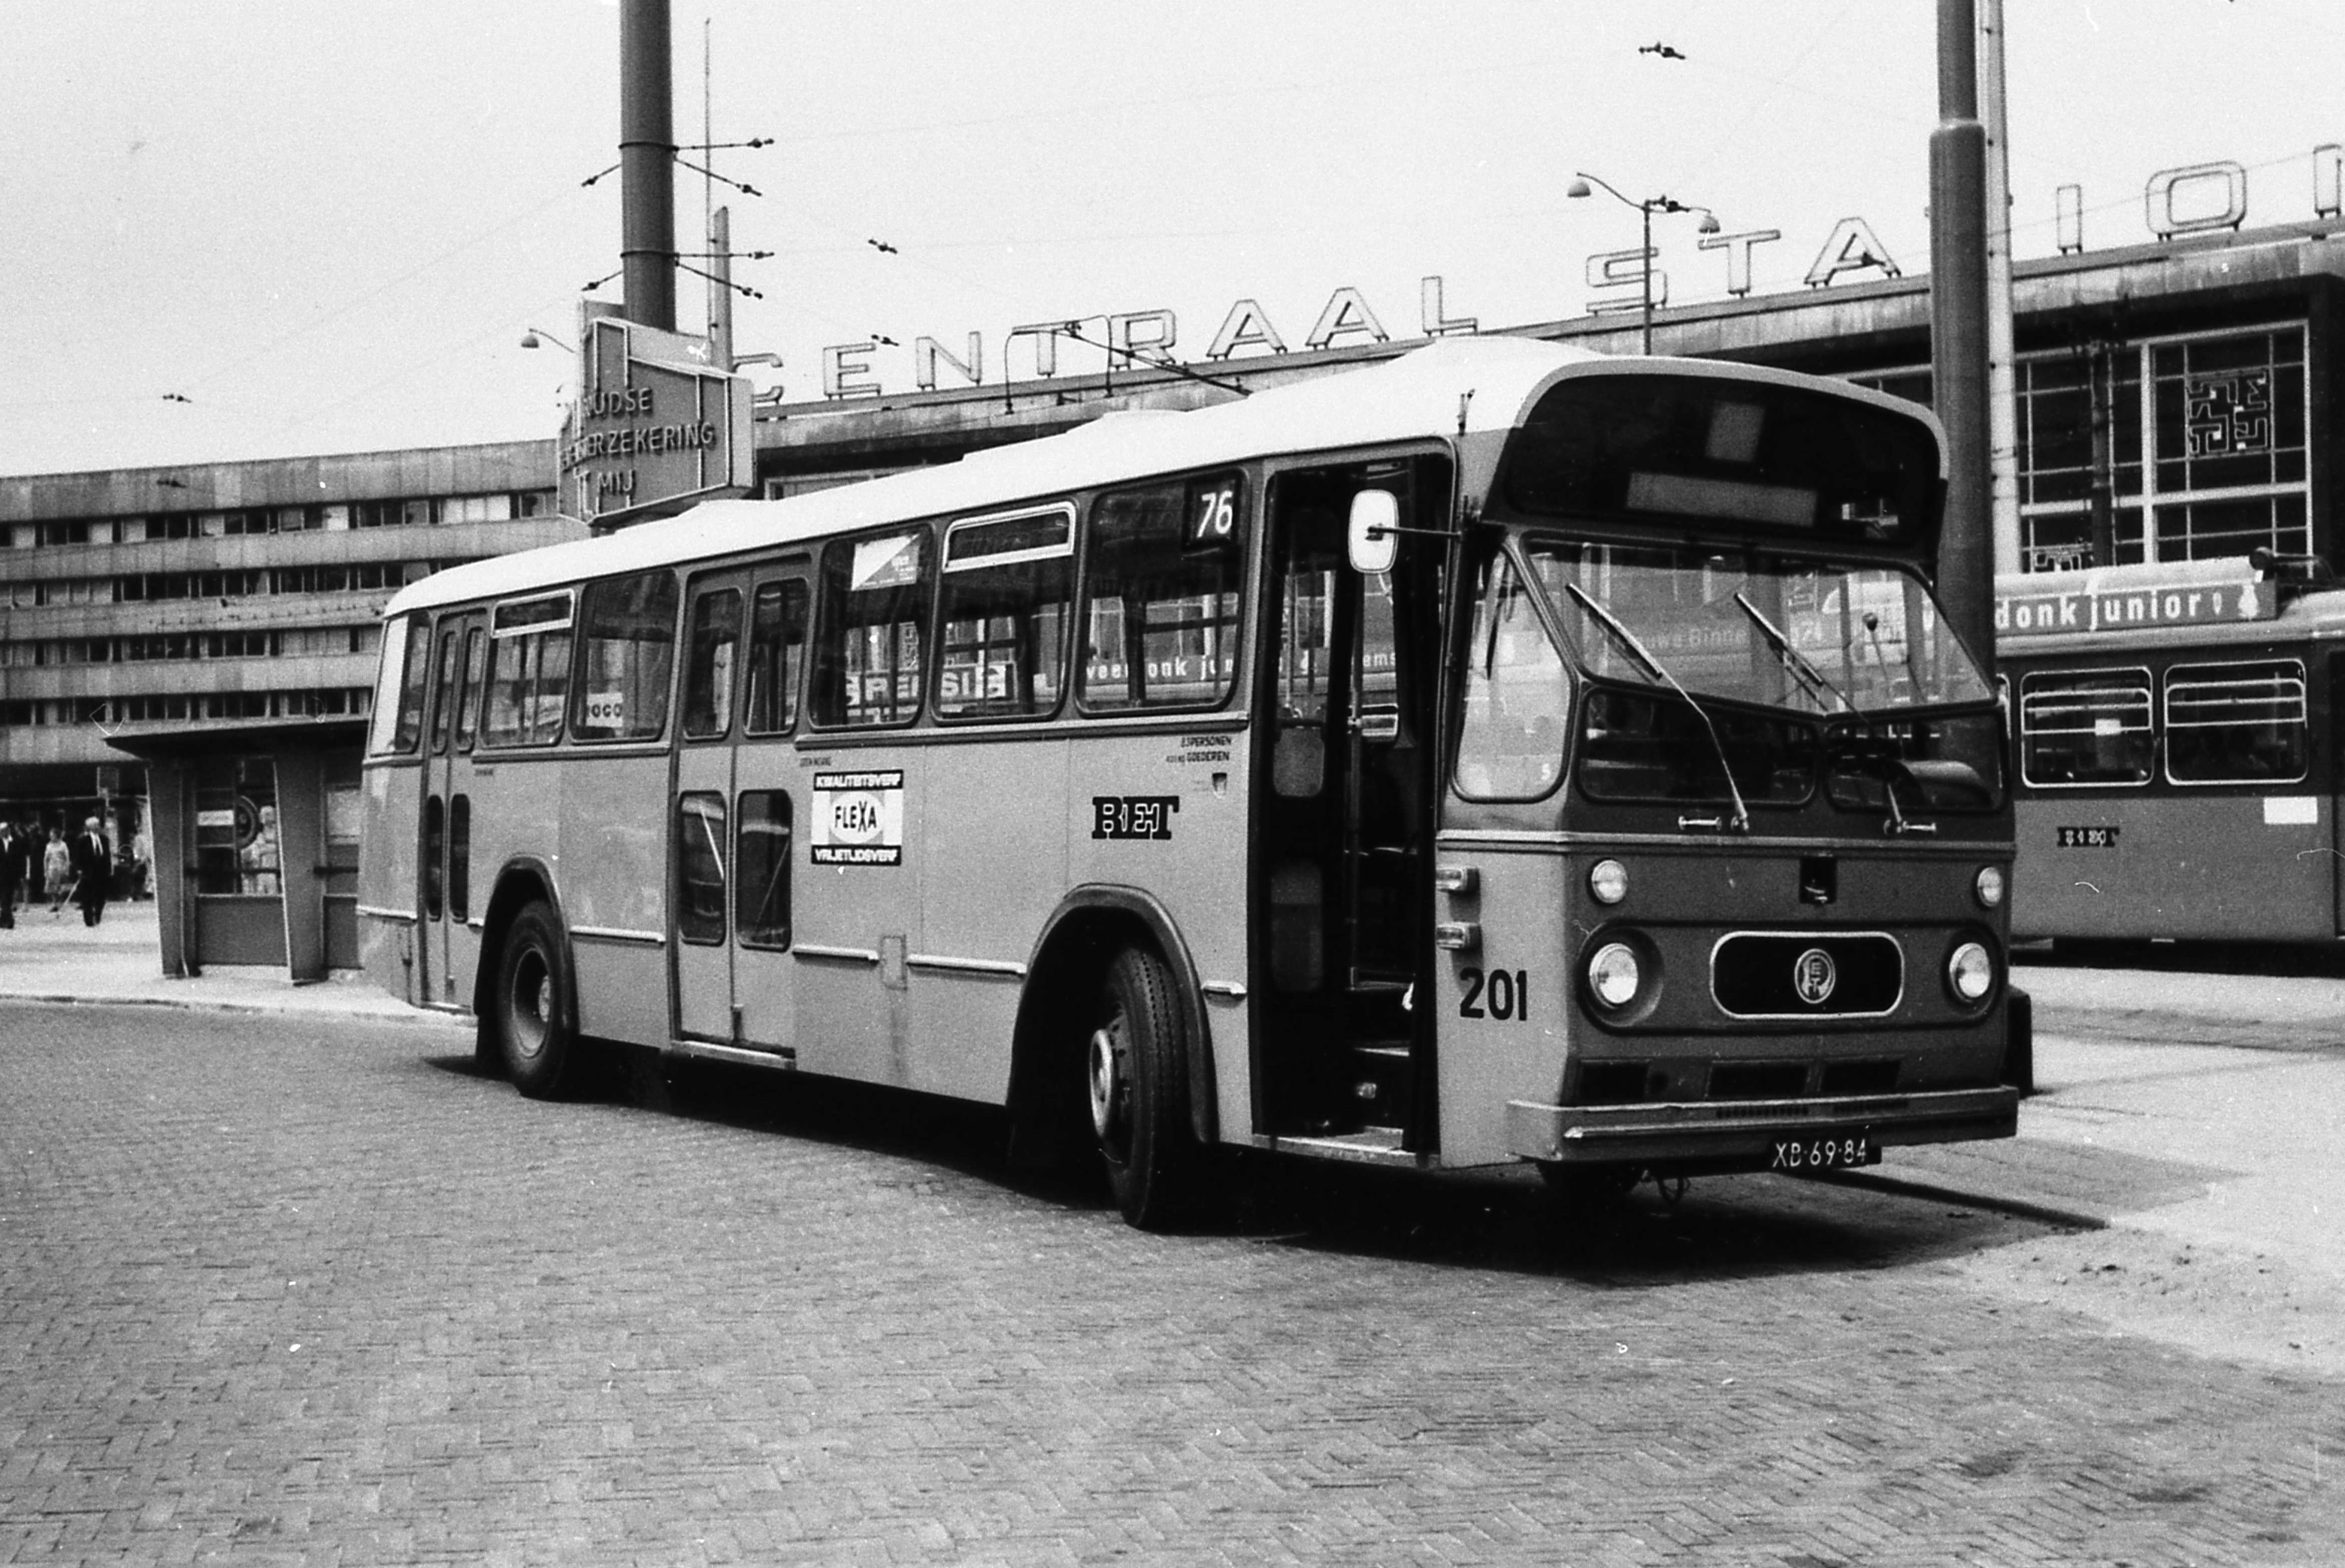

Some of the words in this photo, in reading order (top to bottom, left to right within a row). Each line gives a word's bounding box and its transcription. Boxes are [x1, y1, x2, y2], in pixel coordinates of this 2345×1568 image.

[1196, 490, 1234, 538] 76
[2088, 588, 2202, 632] junior
[834, 800, 877, 833] FLEXA
[1092, 796, 1180, 840] RET
[1459, 968, 1528, 1021] 201
